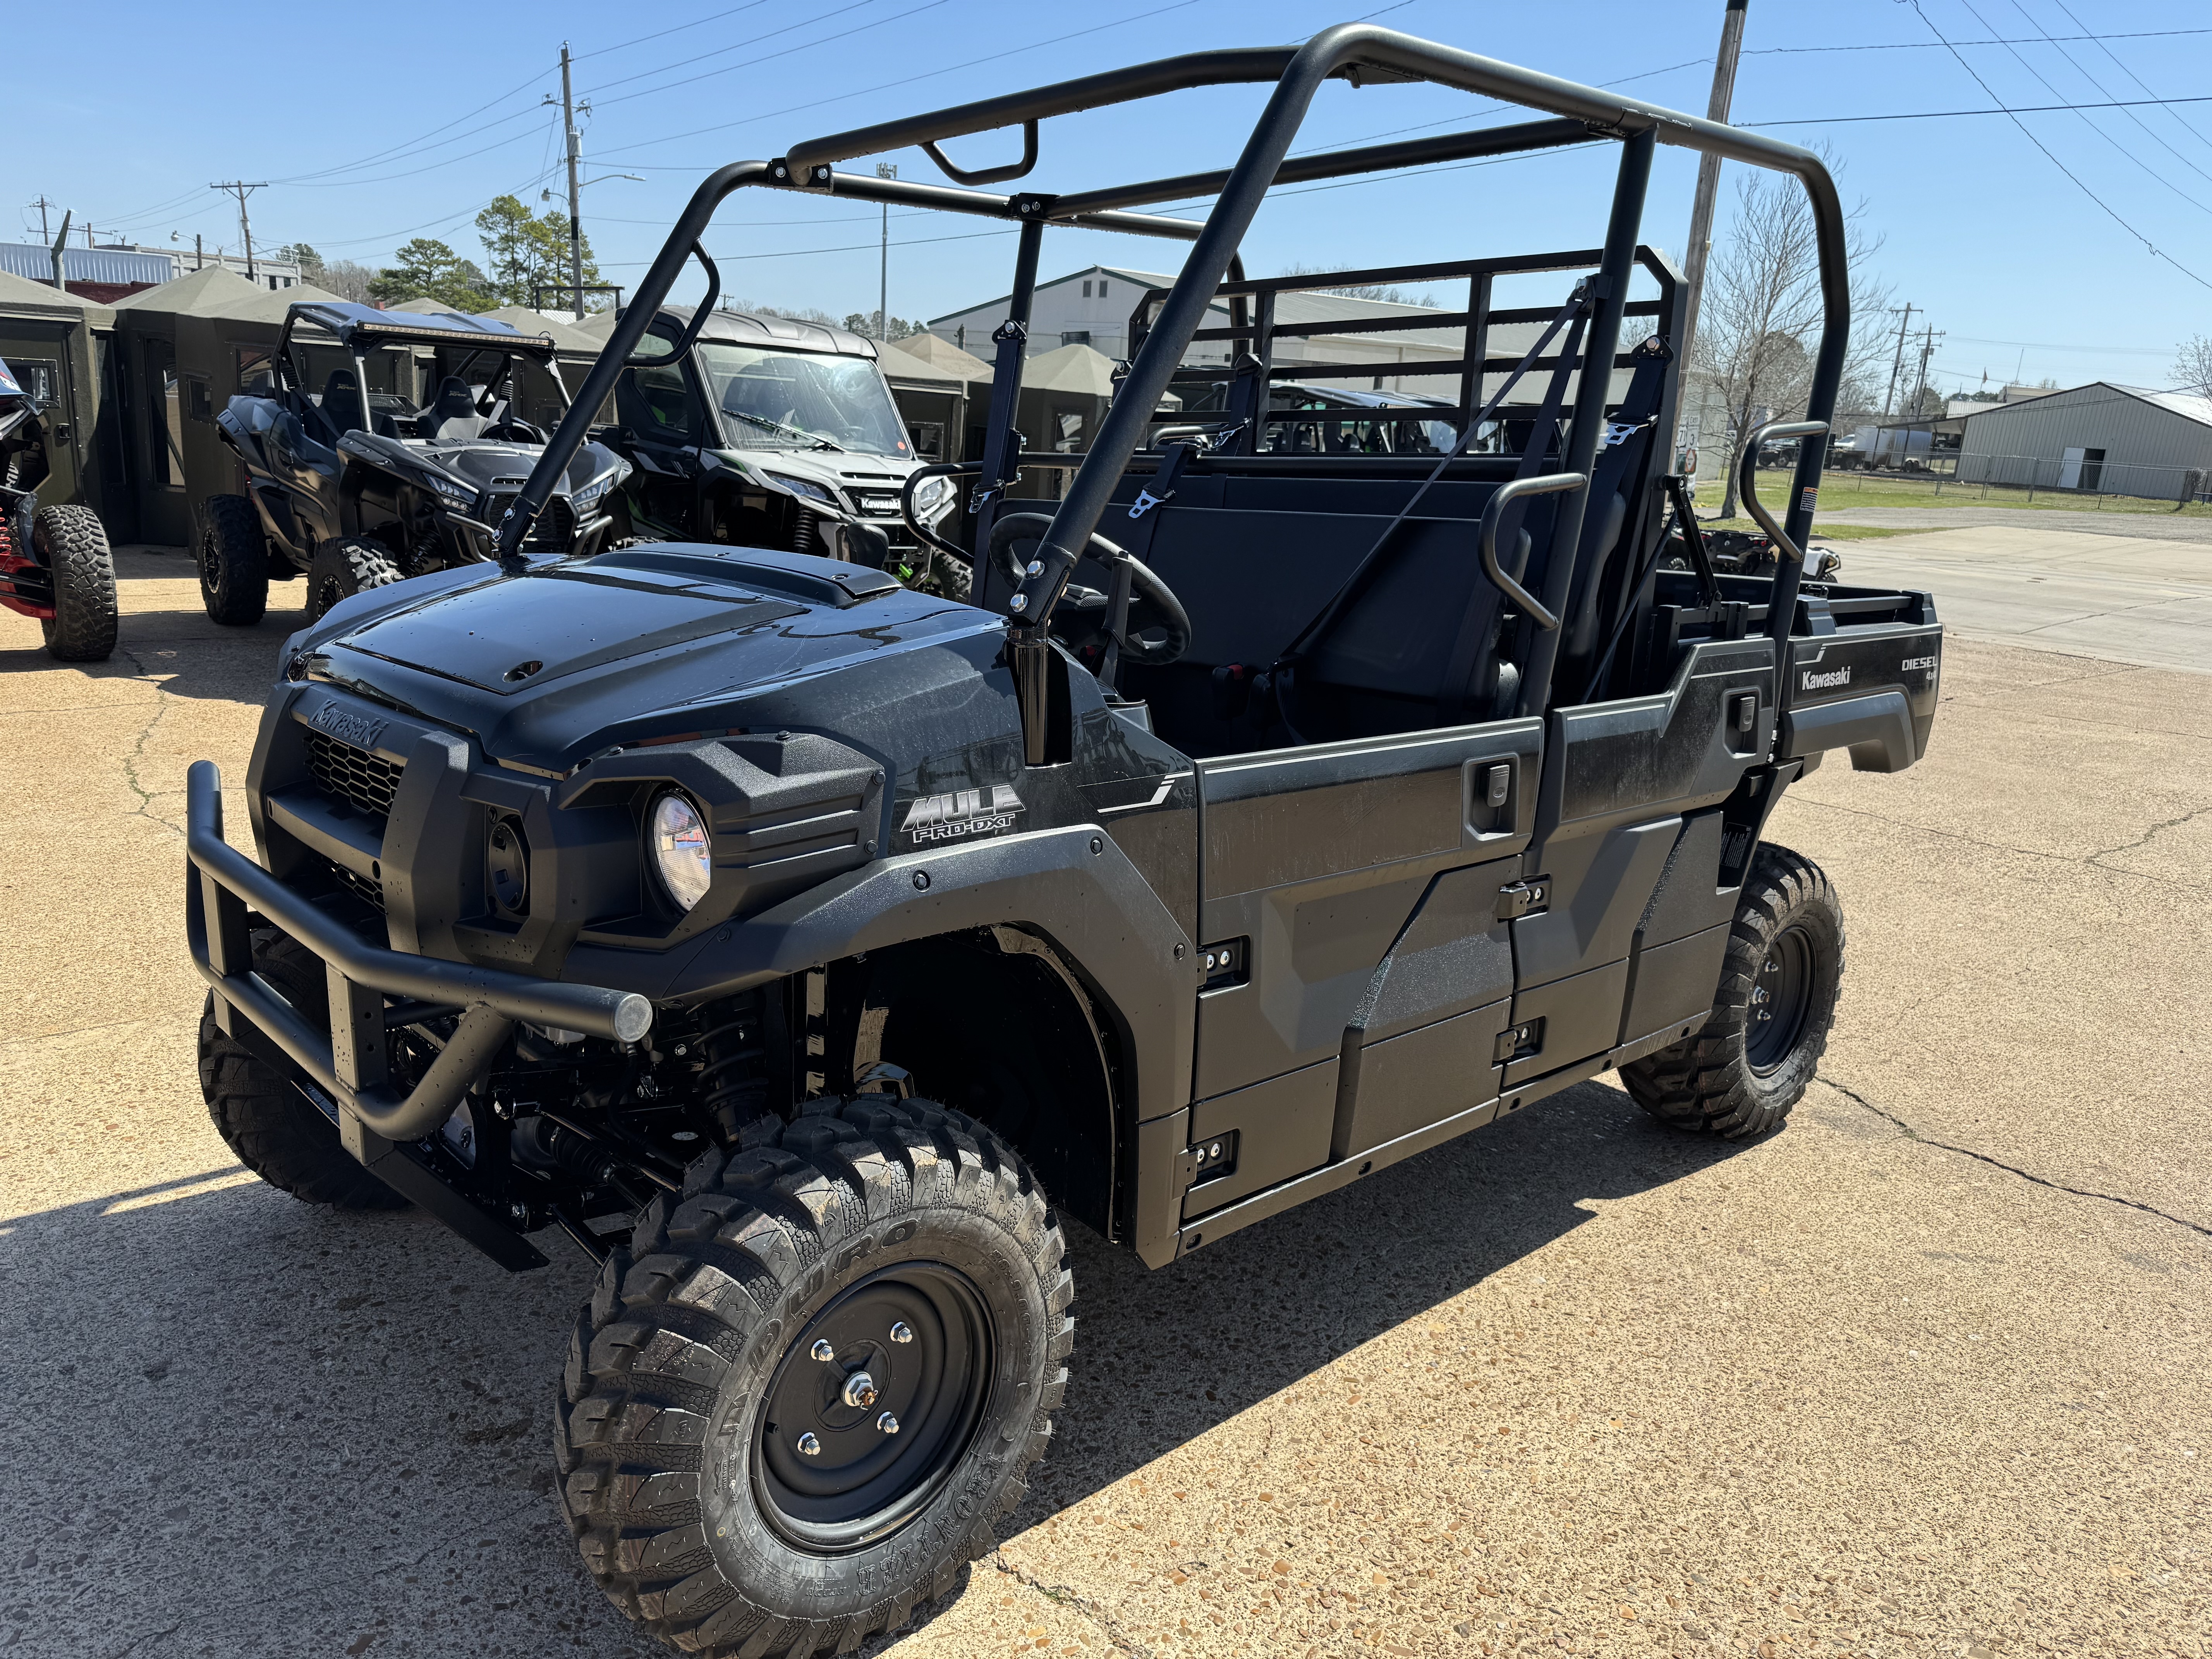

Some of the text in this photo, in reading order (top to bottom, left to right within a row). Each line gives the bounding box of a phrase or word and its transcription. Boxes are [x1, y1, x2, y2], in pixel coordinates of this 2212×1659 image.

[1680, 430, 1686, 442] 71
[1690, 433, 1694, 446] 3
[861, 498, 901, 509] Kawasaki
[1901, 655, 1937, 672] DIESEL
[1926, 670, 1937, 681] 4x4
[1802, 666, 1851, 690] Kawasaki
[310, 699, 389, 746] Kawasaki
[900, 783, 1027, 832] MULE
[913, 813, 1015, 844] PRO-DXT
[750, 1219, 921, 1372] DURO
[857, 1452, 1007, 1596] FRONTIER
